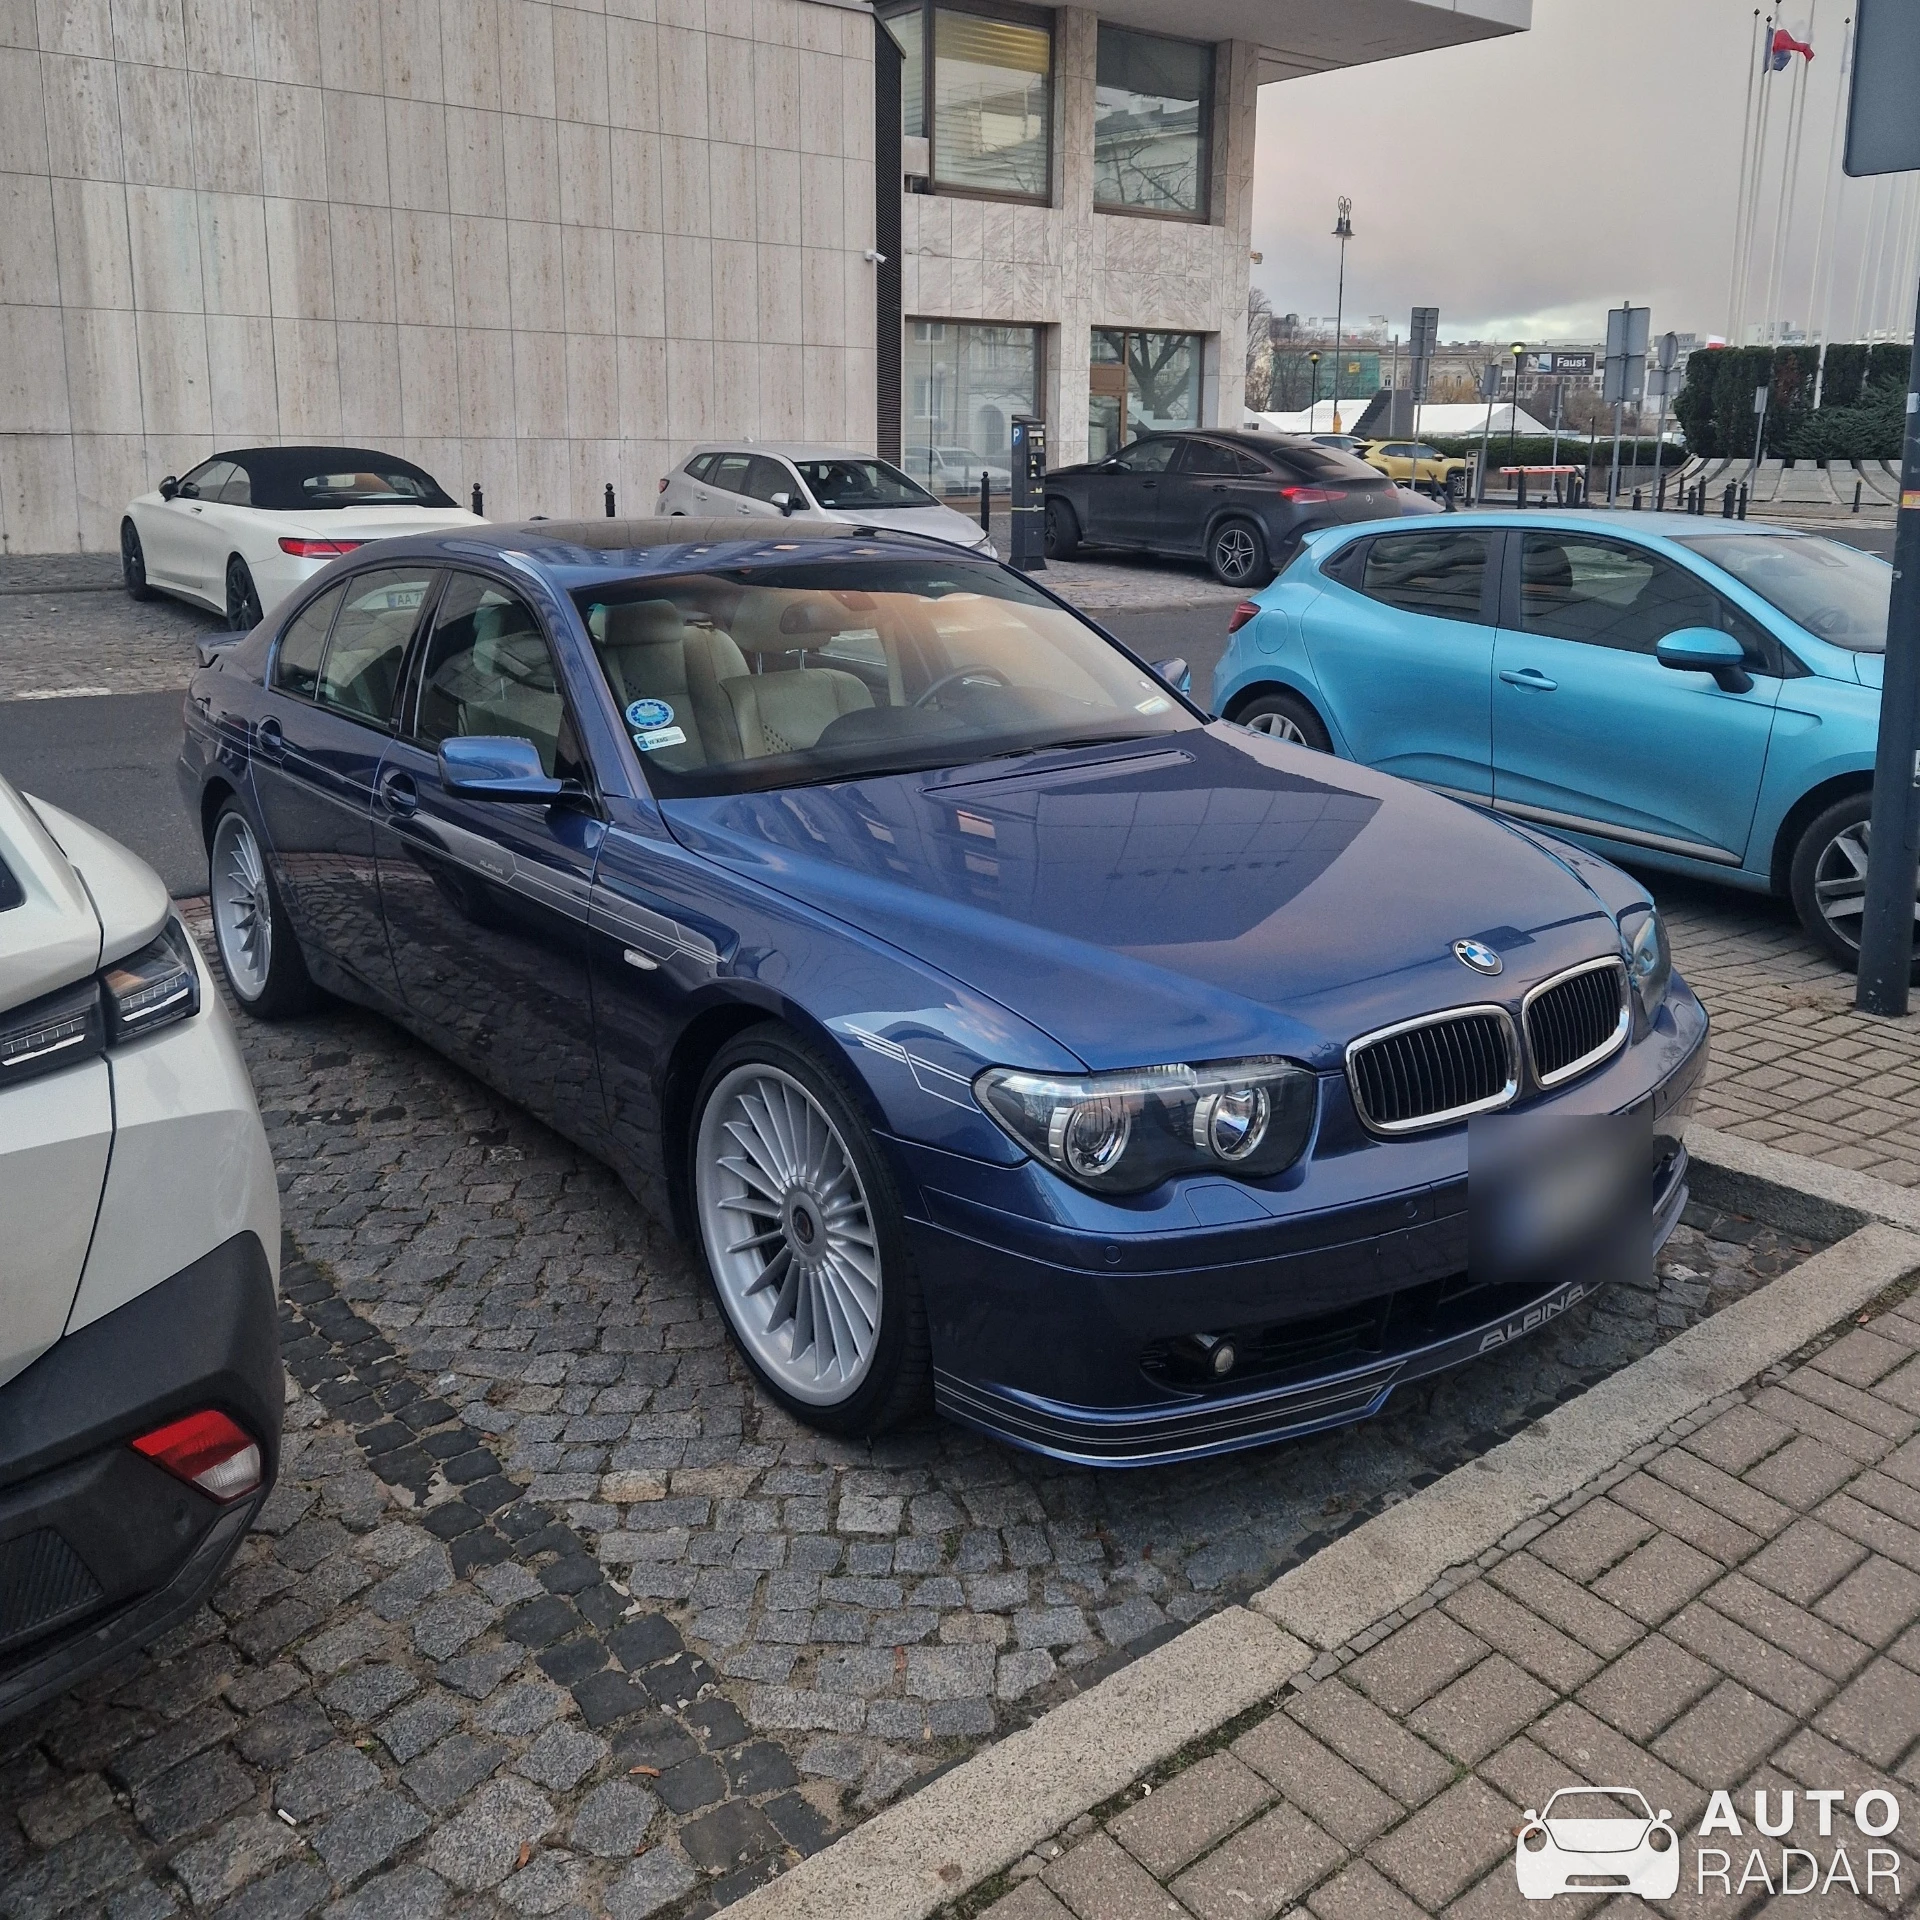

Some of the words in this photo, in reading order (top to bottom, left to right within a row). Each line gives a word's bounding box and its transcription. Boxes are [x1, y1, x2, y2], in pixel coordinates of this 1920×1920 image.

[1556, 357, 1587, 368] Faust
[1013, 428, 1020, 442] P
[1478, 1285, 1585, 1351] ALPINA
